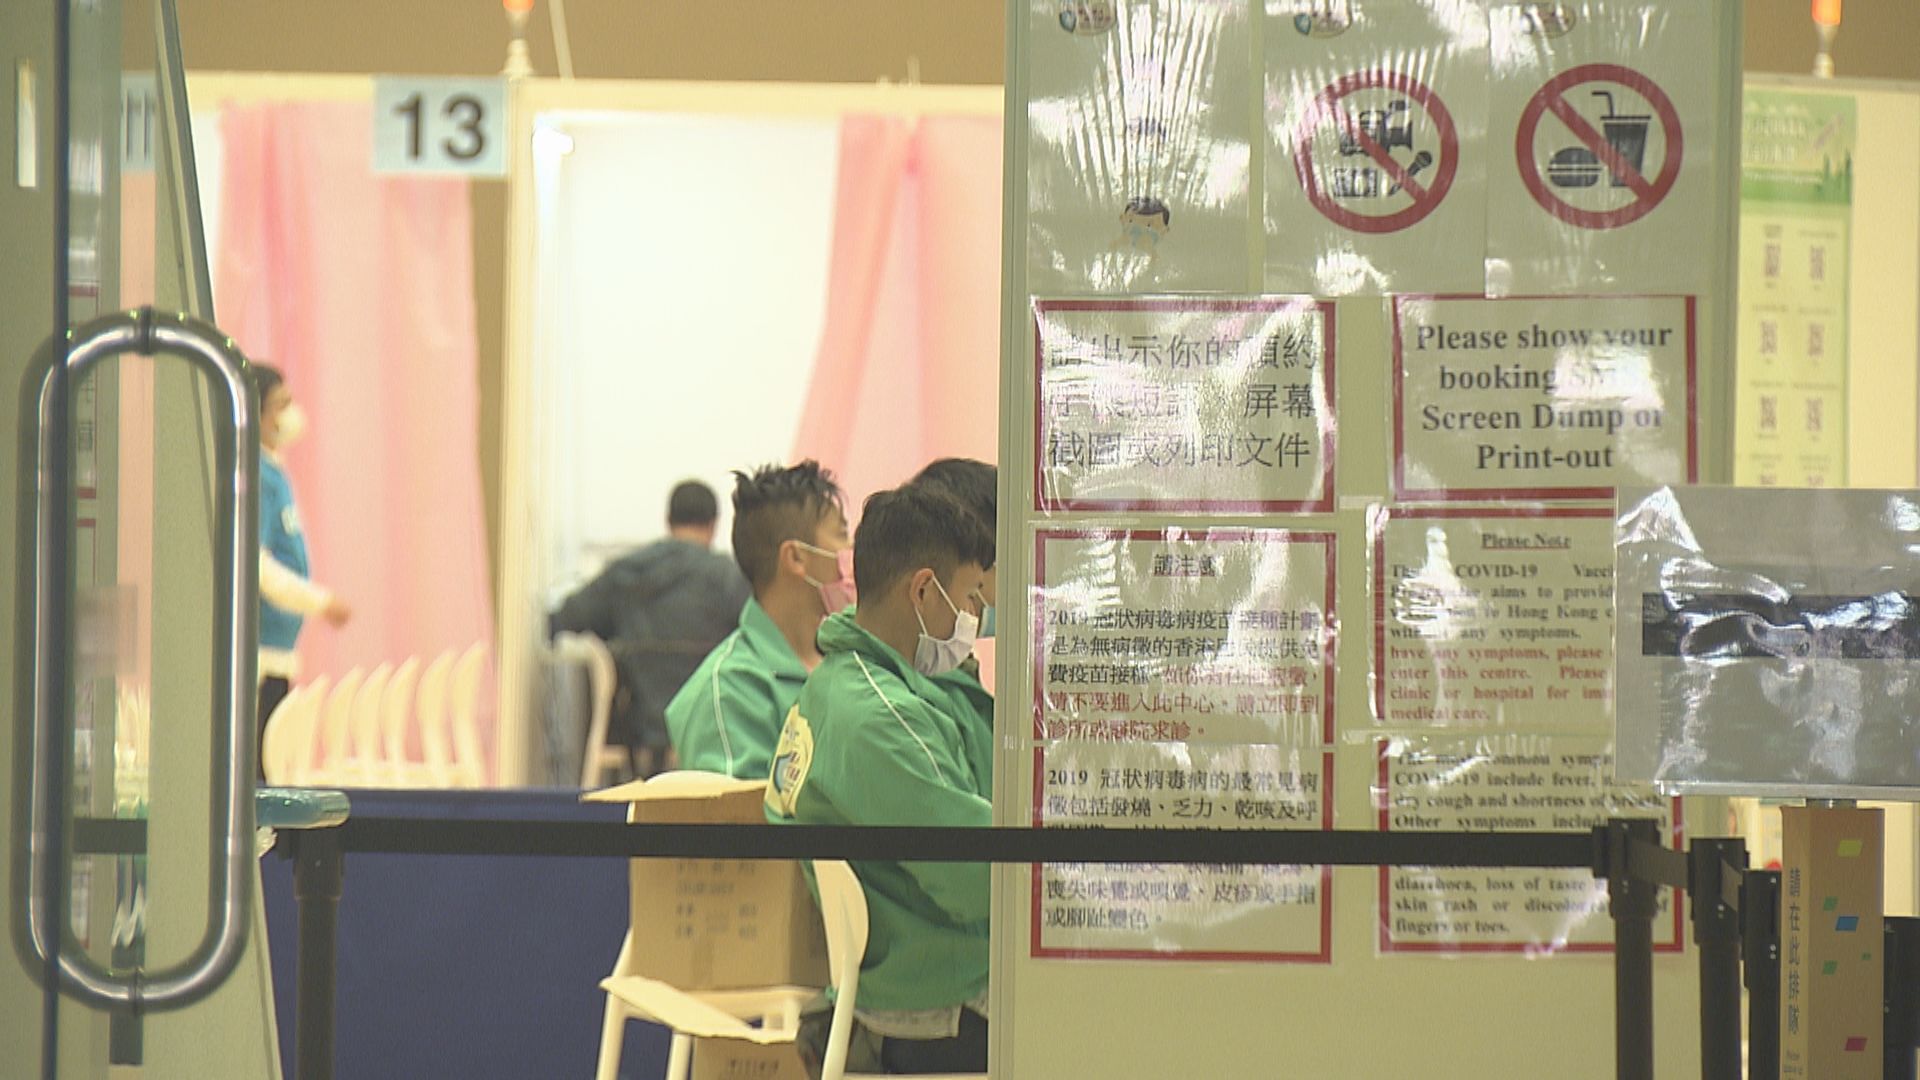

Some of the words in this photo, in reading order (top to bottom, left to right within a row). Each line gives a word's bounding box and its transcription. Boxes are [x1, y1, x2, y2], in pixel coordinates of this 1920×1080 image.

[391, 92, 485, 162] 13
[1416, 325, 1508, 350] Please
[1517, 324, 1595, 349] show
[1603, 329, 1673, 352] your
[1439, 365, 1558, 394] booking
[1422, 404, 1521, 431] Screen
[1532, 404, 1623, 435] Dump
[1476, 445, 1614, 470] Print-out
[1481, 533, 1530, 549] Please
[1535, 533, 1572, 549] Note
[1455, 563, 1538, 578] COVID-19
[1490, 584, 1527, 598] aims
[1537, 586, 1553, 598] to
[1507, 604, 1549, 621] Hong
[1557, 604, 1598, 621] Kong
[1499, 625, 1581, 642] symptoms.
[1391, 645, 1425, 659] have
[1557, 644, 1602, 662] please
[1390, 666, 1430, 679] enter
[1440, 665, 1469, 679] this
[1559, 665, 1606, 680] Please
[1390, 685, 1431, 700] clinic
[1444, 688, 1462, 700] or
[1473, 685, 1534, 703] hospital
[1547, 684, 1570, 700] for
[1048, 768, 1088, 785] 2019
[1395, 771, 1480, 786] COV-19
[1487, 771, 1545, 786] include
[1426, 793, 1473, 810] cough
[1478, 792, 1508, 807] and
[1513, 793, 1585, 807] shortness
[1395, 814, 1441, 828] Other
[1456, 815, 1536, 831] symptoms
[1486, 876, 1515, 891] loss
[1522, 876, 1540, 891] of
[1395, 896, 1428, 912] skin
[1444, 897, 1478, 912] rash
[1491, 899, 1511, 912] or
[1395, 917, 1448, 935] fingers
[1453, 920, 1471, 933] or
[1475, 919, 1510, 934] toes.
